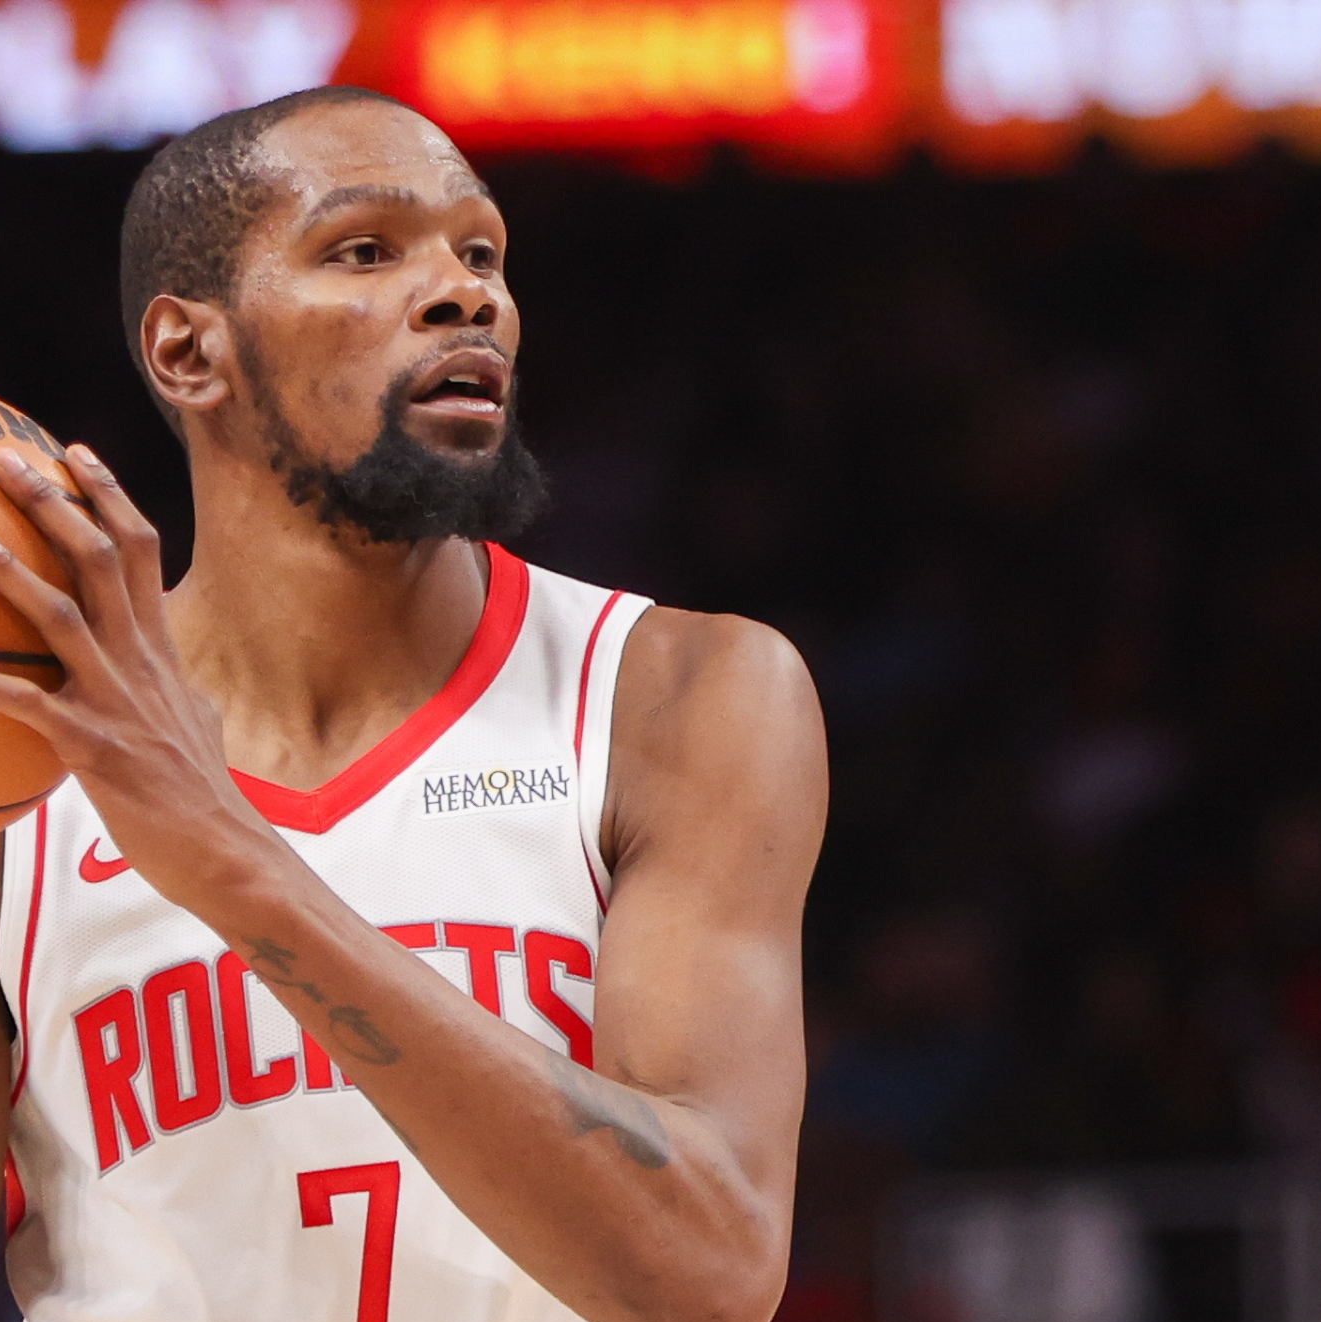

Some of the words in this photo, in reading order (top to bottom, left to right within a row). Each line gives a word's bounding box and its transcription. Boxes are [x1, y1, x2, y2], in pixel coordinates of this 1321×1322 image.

[423, 765, 570, 798] MEMORIAL
[424, 781, 569, 815] HERMANN
[73, 919, 596, 1180] ROCTS
